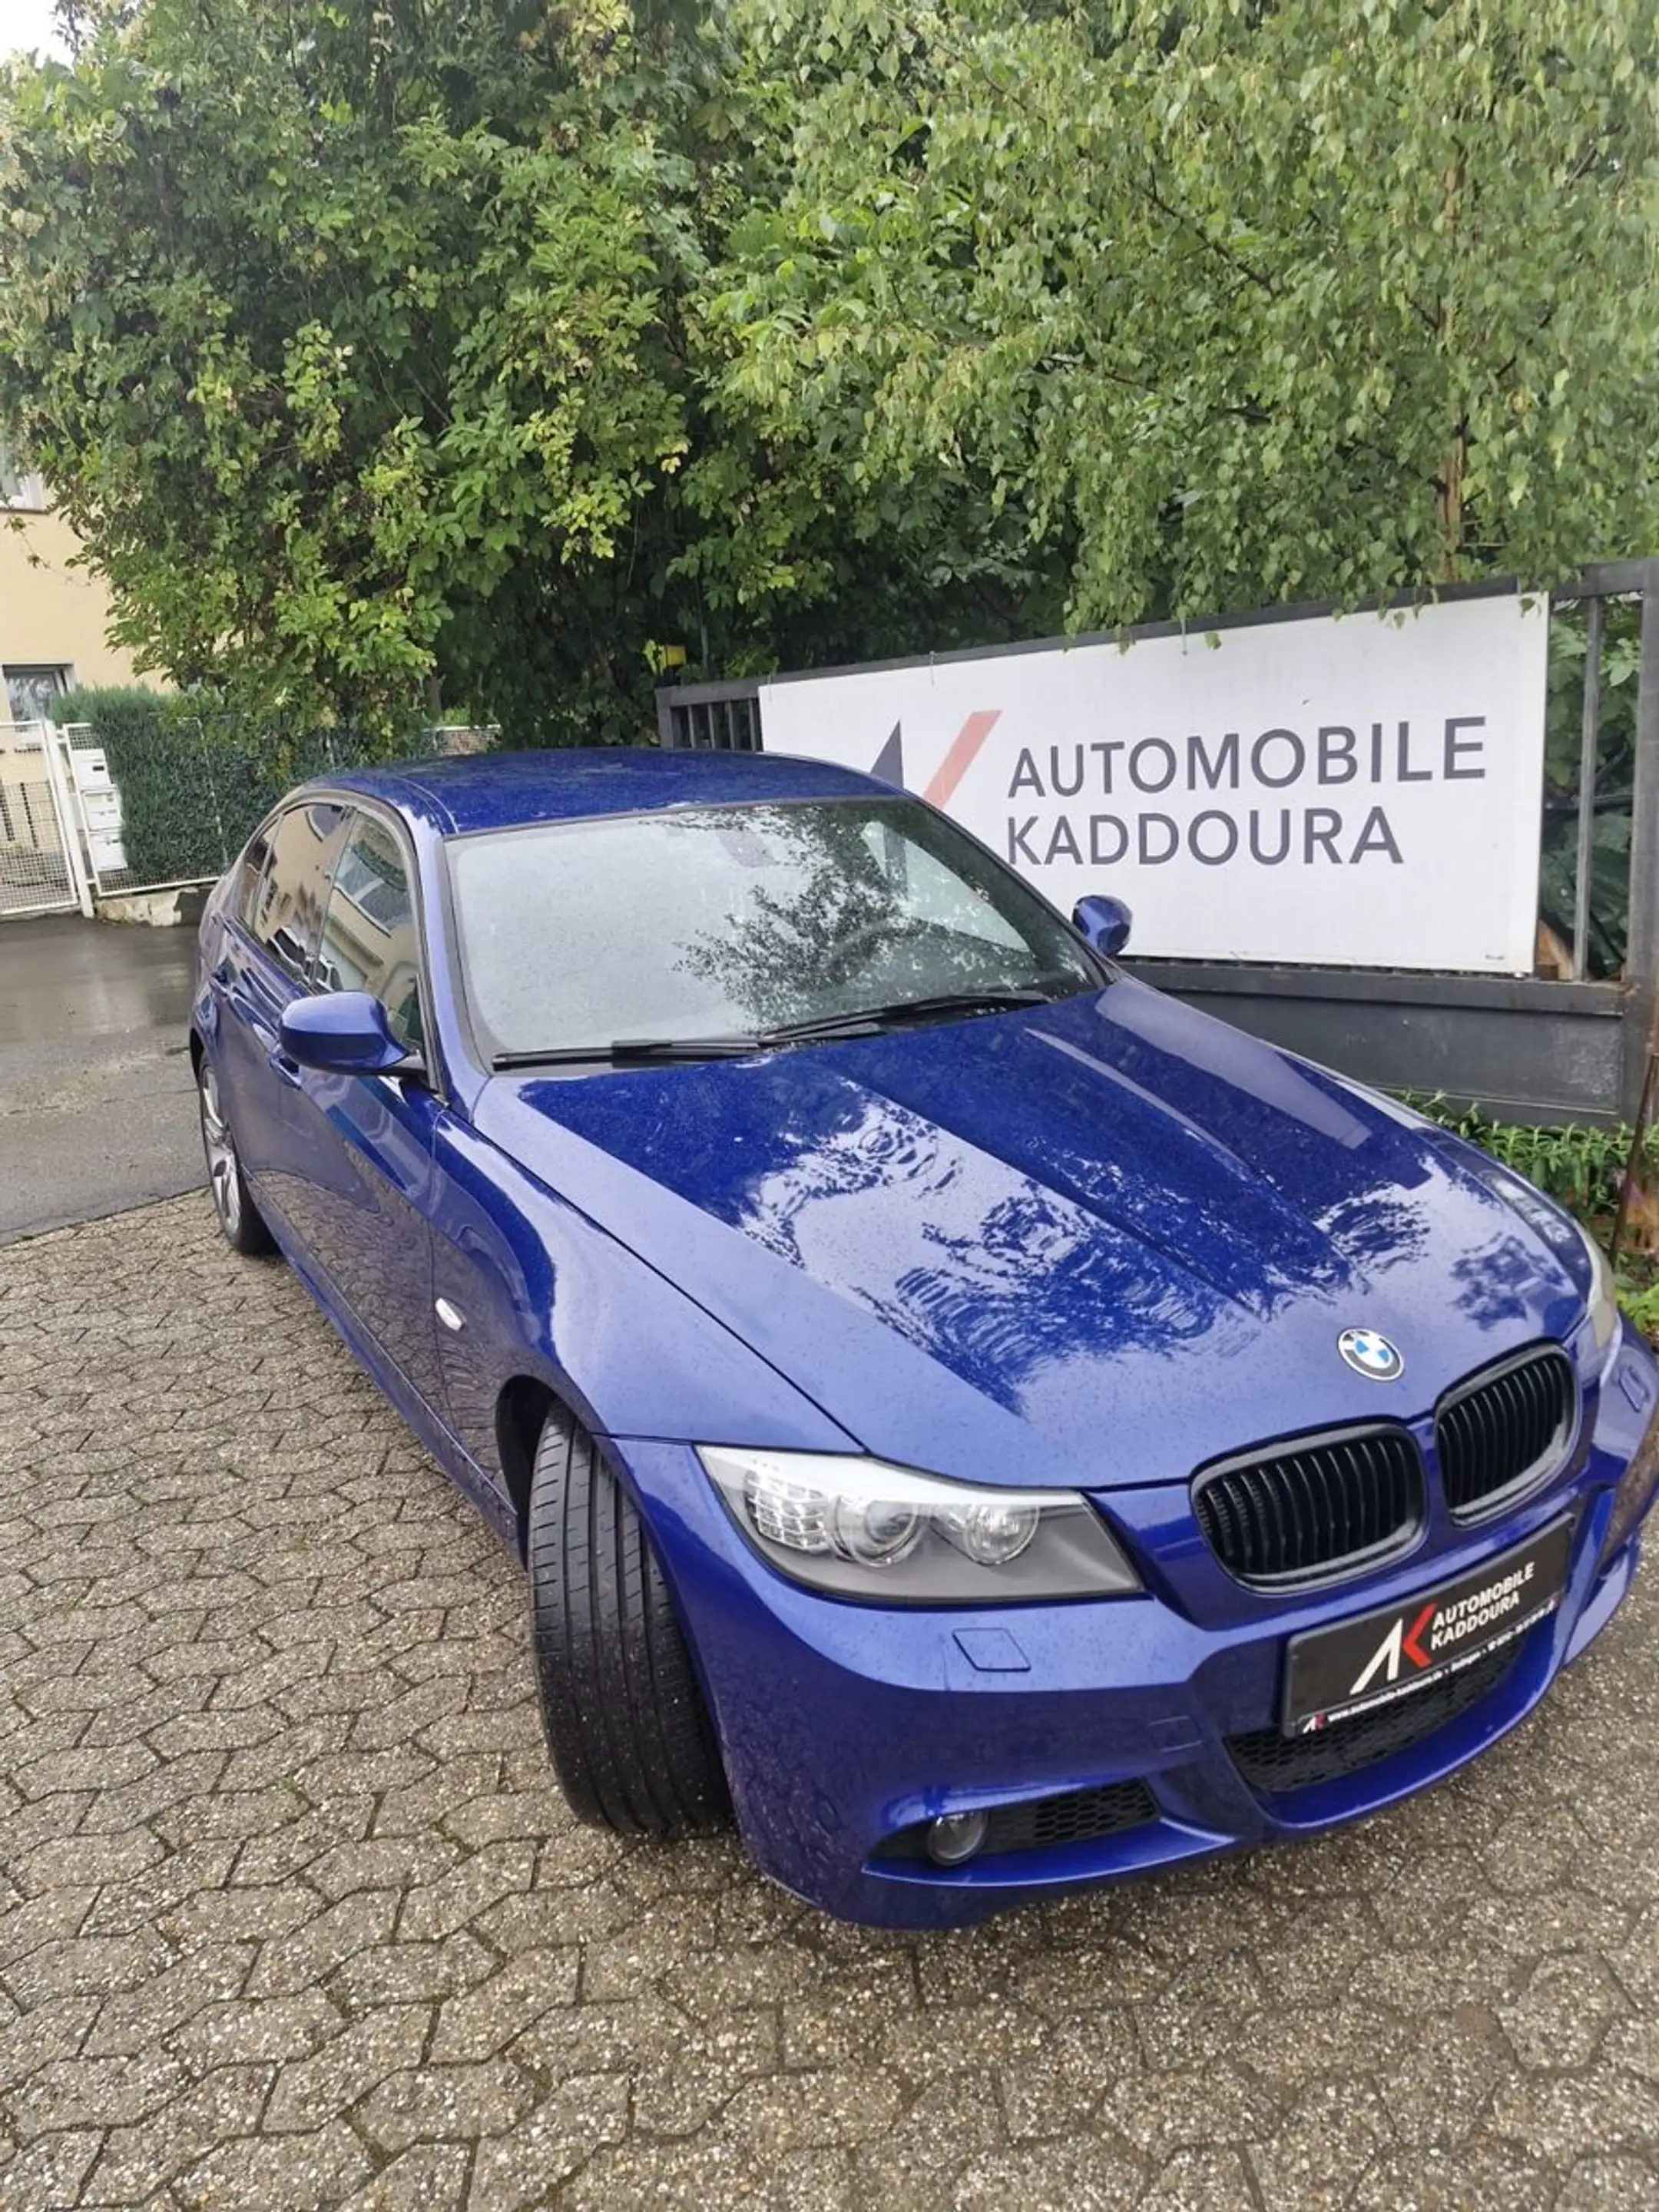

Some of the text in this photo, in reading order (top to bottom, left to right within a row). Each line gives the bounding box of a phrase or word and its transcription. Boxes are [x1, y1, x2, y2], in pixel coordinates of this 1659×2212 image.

[1008, 715, 1486, 799] AUTOMOBILE
[1008, 805, 1403, 866] KADDOURA
[1430, 1591, 1520, 1651] KADDOURA
[1432, 1561, 1535, 1631] AUTOMOBILE
